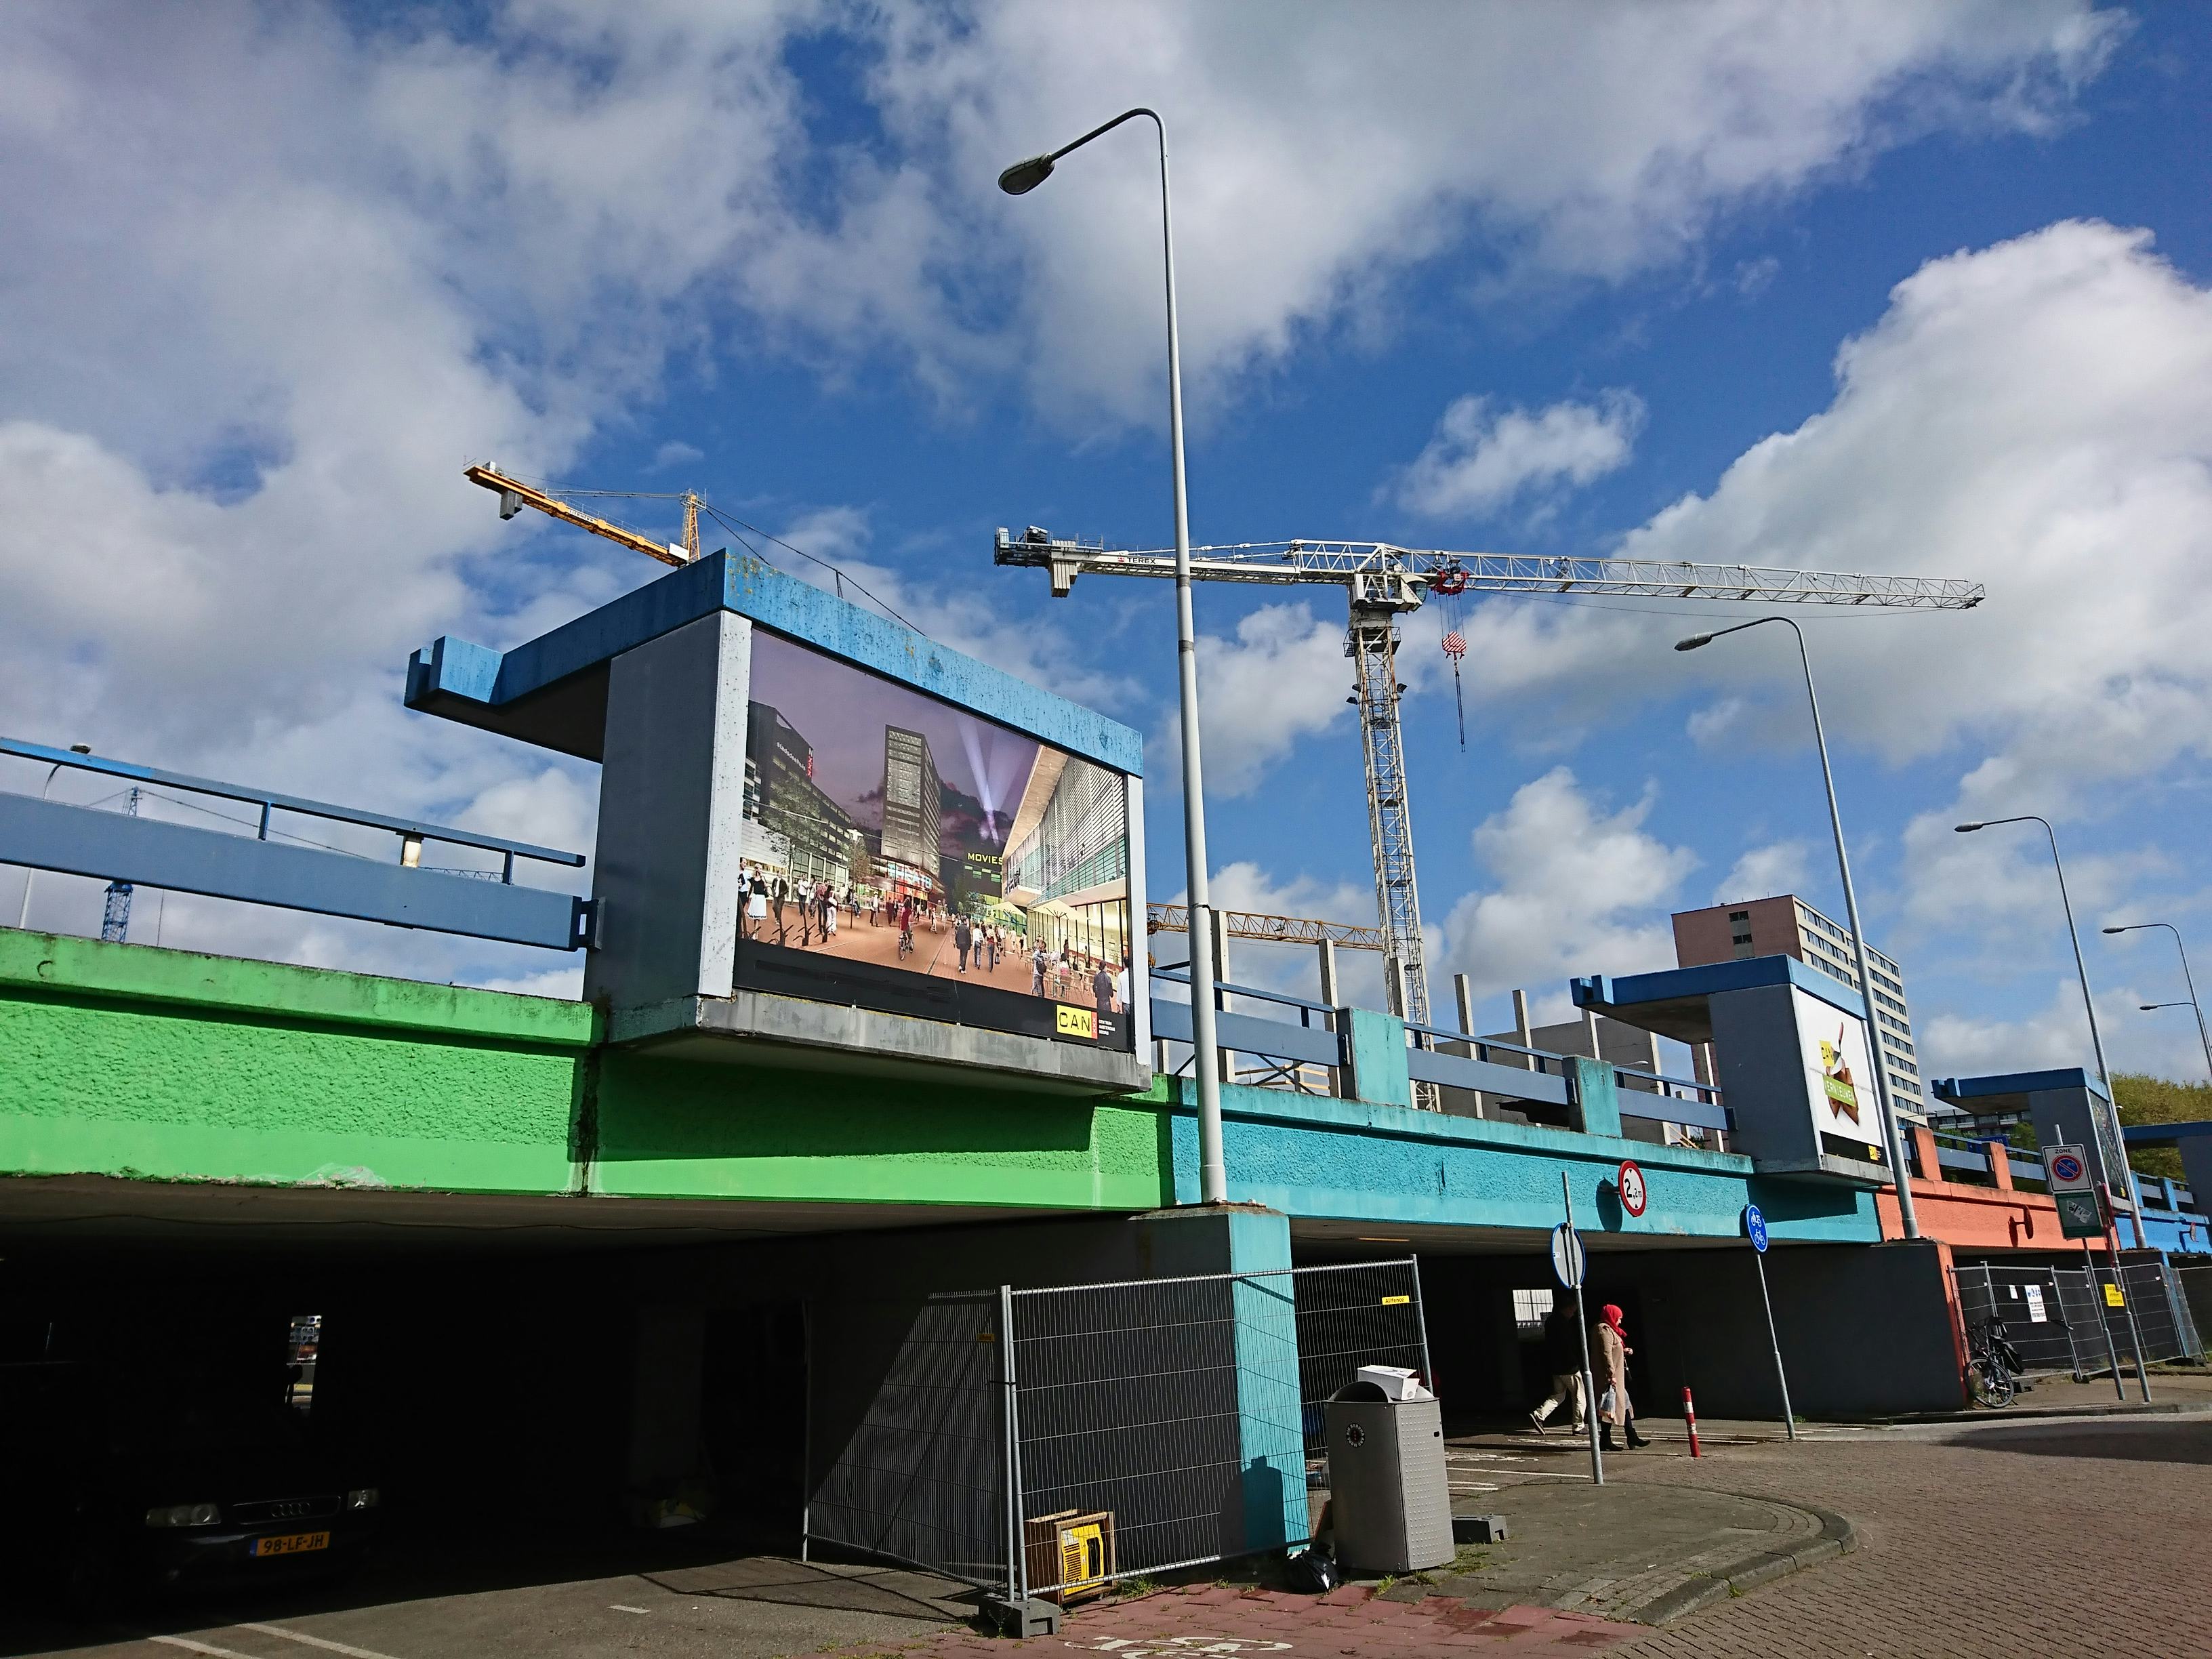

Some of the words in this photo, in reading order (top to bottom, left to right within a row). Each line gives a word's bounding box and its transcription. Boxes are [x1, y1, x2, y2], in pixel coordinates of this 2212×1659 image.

[967, 852, 1003, 865] MOVIES
[1059, 1012, 1090, 1032] CAN
[264, 1534, 325, 1553] 98-LF-JH
